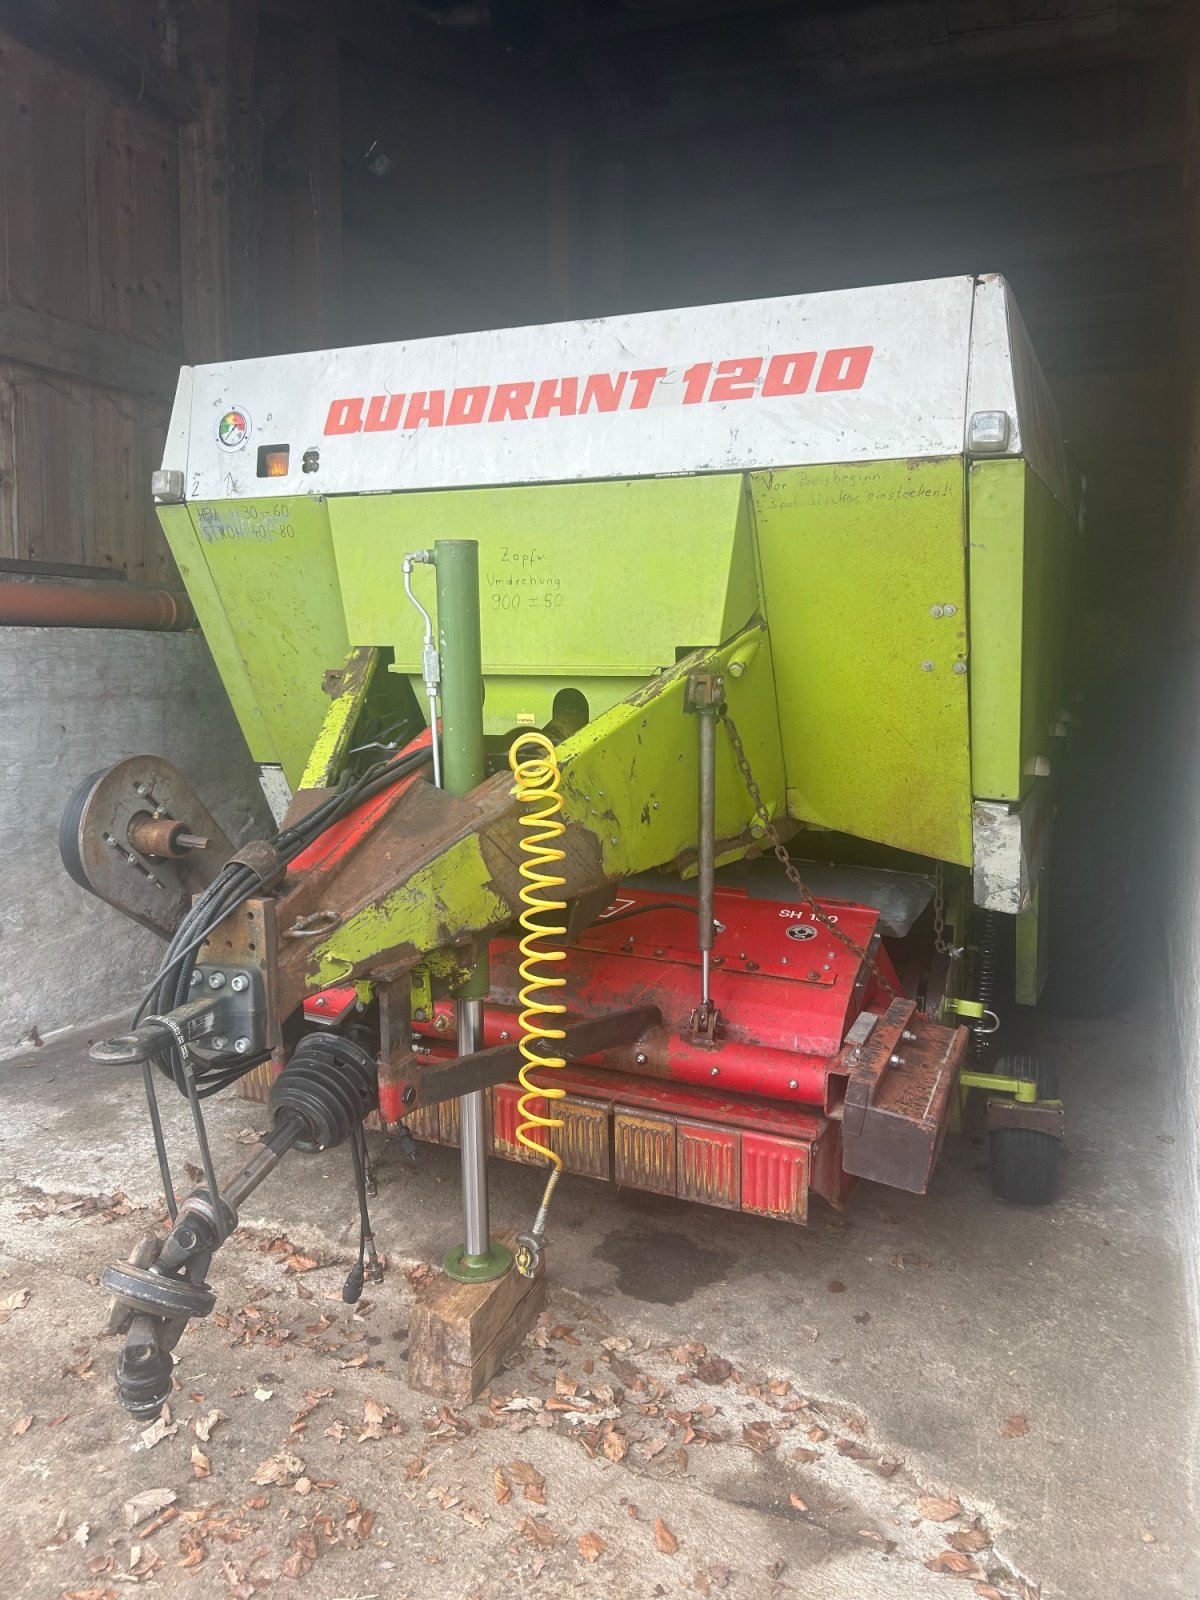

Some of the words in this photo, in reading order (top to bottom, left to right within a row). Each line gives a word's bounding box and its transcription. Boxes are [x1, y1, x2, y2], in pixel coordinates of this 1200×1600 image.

[323, 368, 667, 435] QUADRANT
[682, 346, 873, 405] 1200
[280, 524, 294, 538] 80
[491, 593, 520, 609] 900
[544, 593, 563, 608] 50
[778, 909, 803, 919] SH
